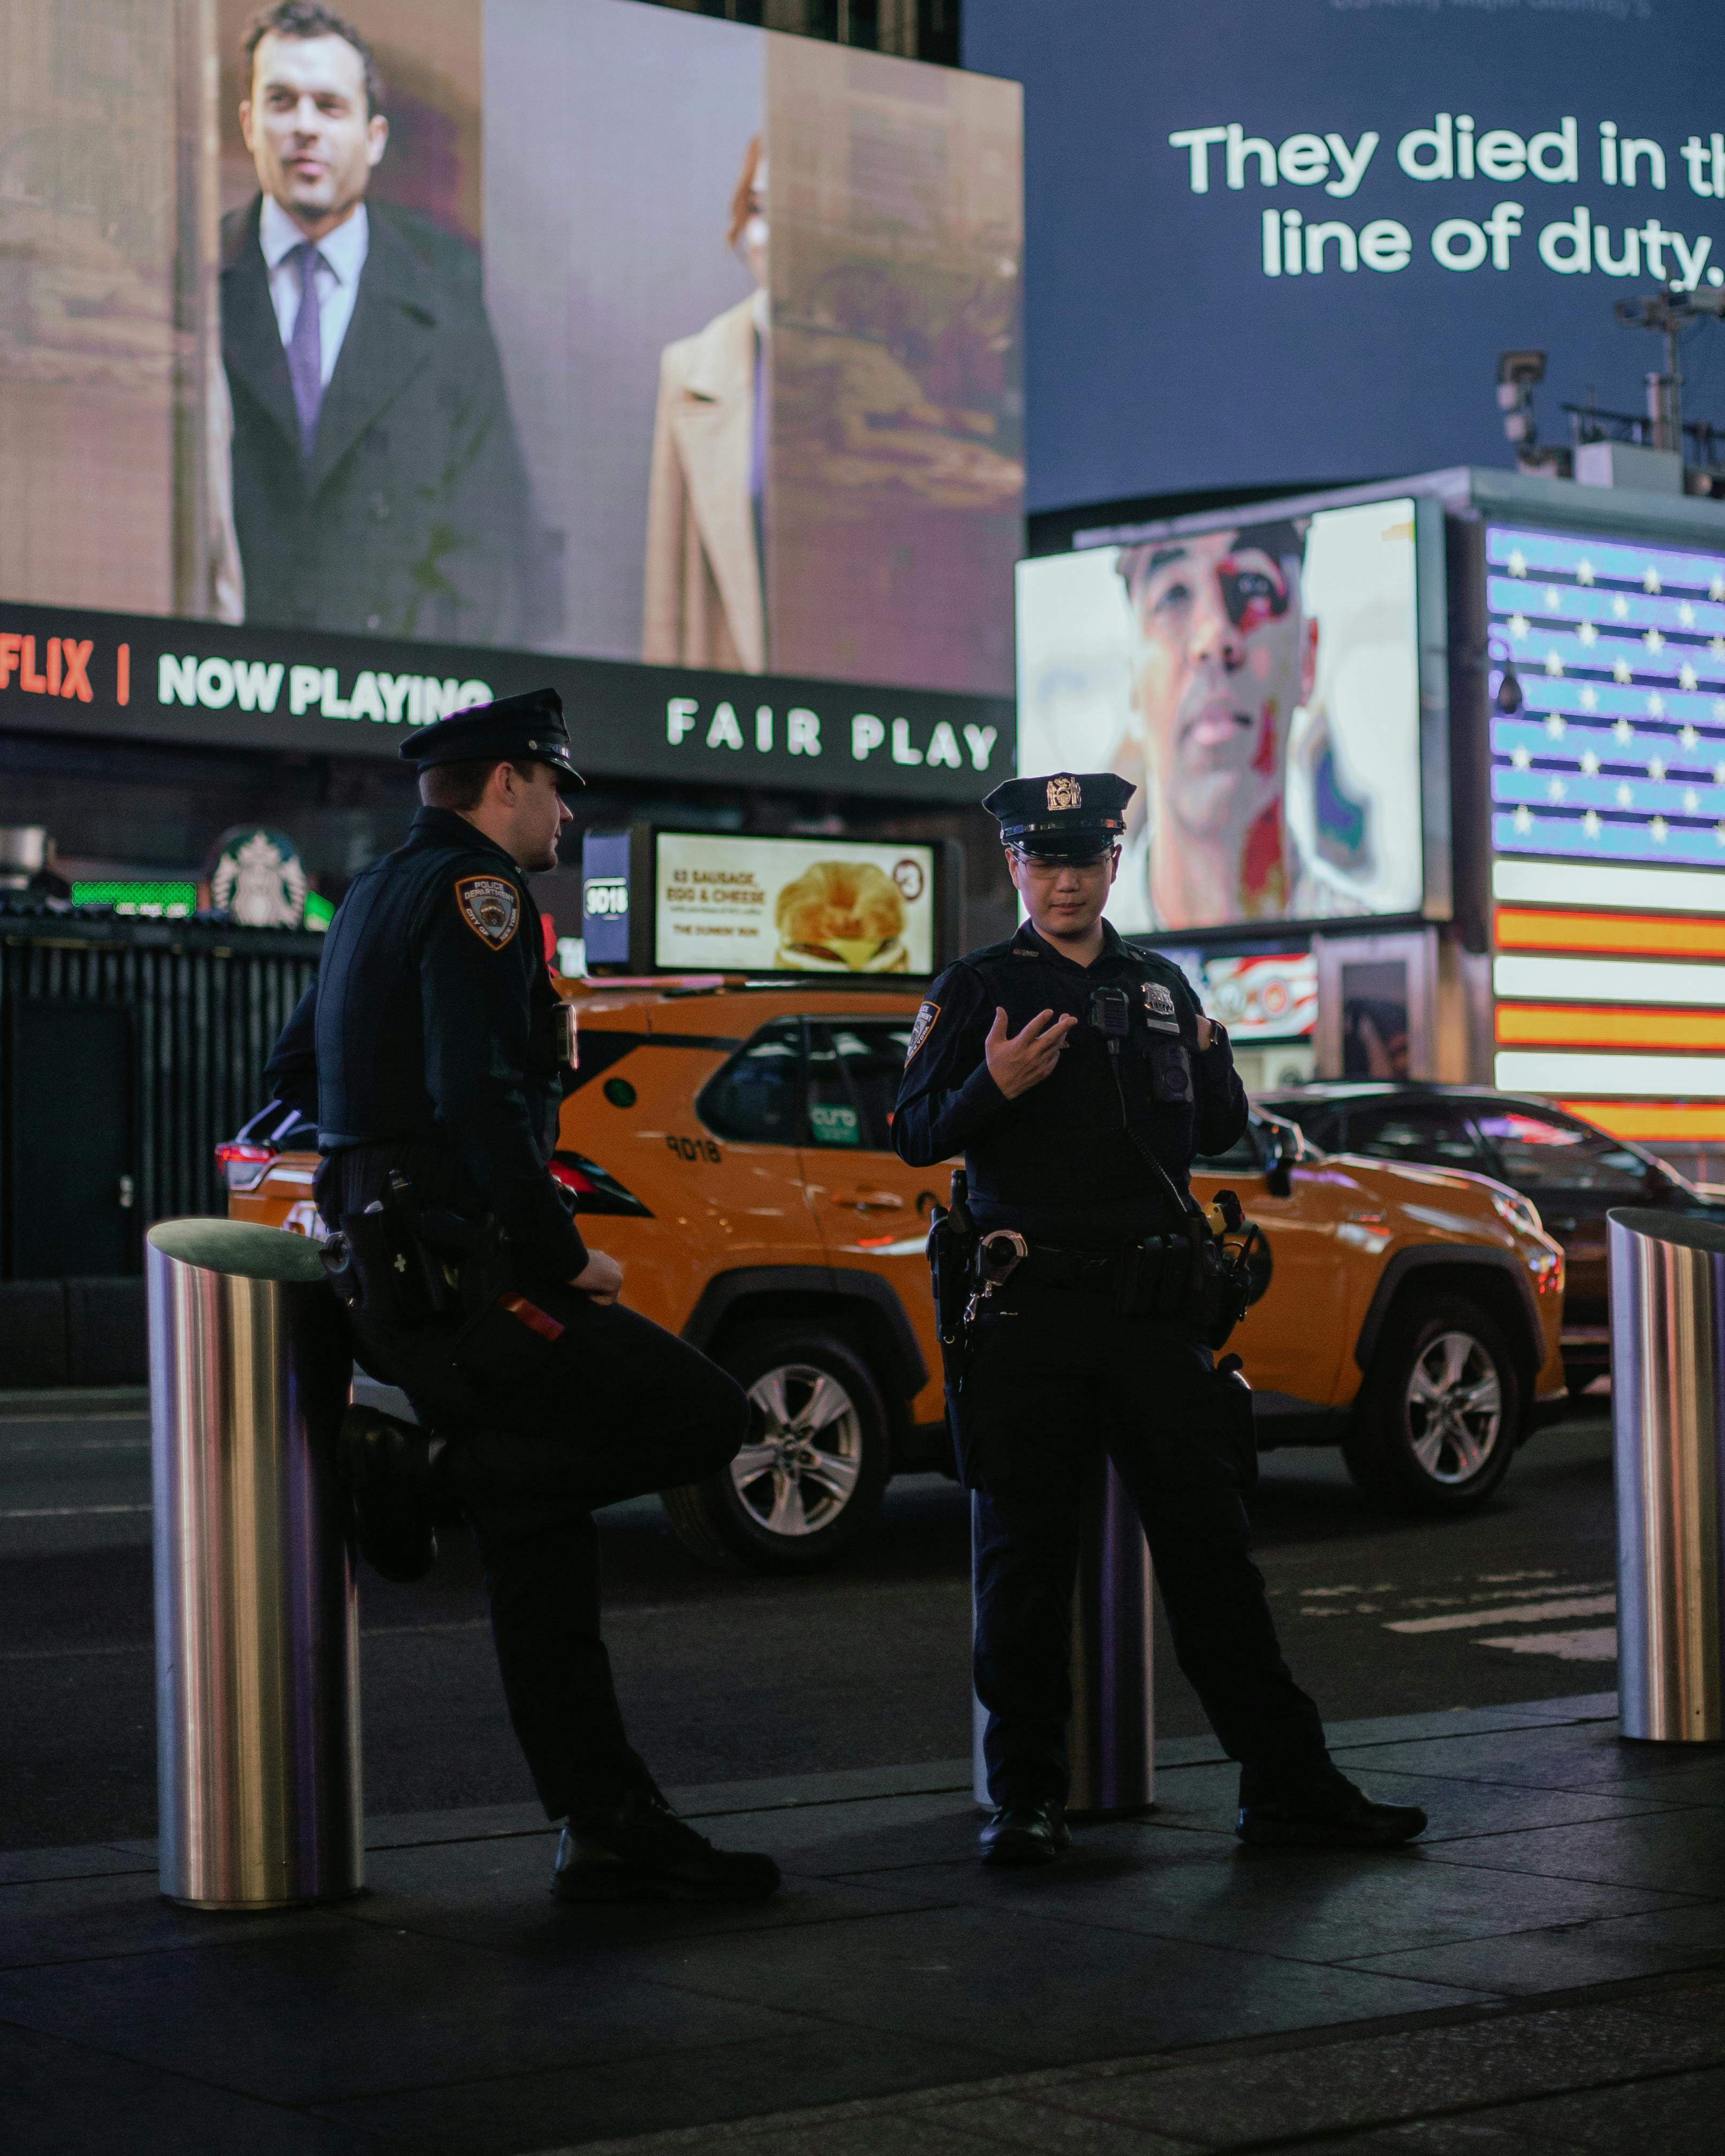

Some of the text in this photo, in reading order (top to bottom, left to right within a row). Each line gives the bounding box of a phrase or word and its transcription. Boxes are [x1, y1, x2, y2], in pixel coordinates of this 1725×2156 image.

[1169, 123, 1379, 198] They
[1397, 113, 1578, 183] died
[1600, 121, 1666, 190] in
[1262, 201, 1724, 292] line of duty.
[0, 633, 94, 703] FLIX
[158, 653, 285, 713] NOW
[667, 697, 998, 771] FAIR PLAY
[464, 889, 514, 903] DEPARTMENT
[474, 881, 504, 891] POLICE
[466, 908, 489, 936] CITY OF
[500, 927, 511, 941] NEW
[917, 1026, 929, 1044] YORK
[666, 1135, 722, 1163] 9018
